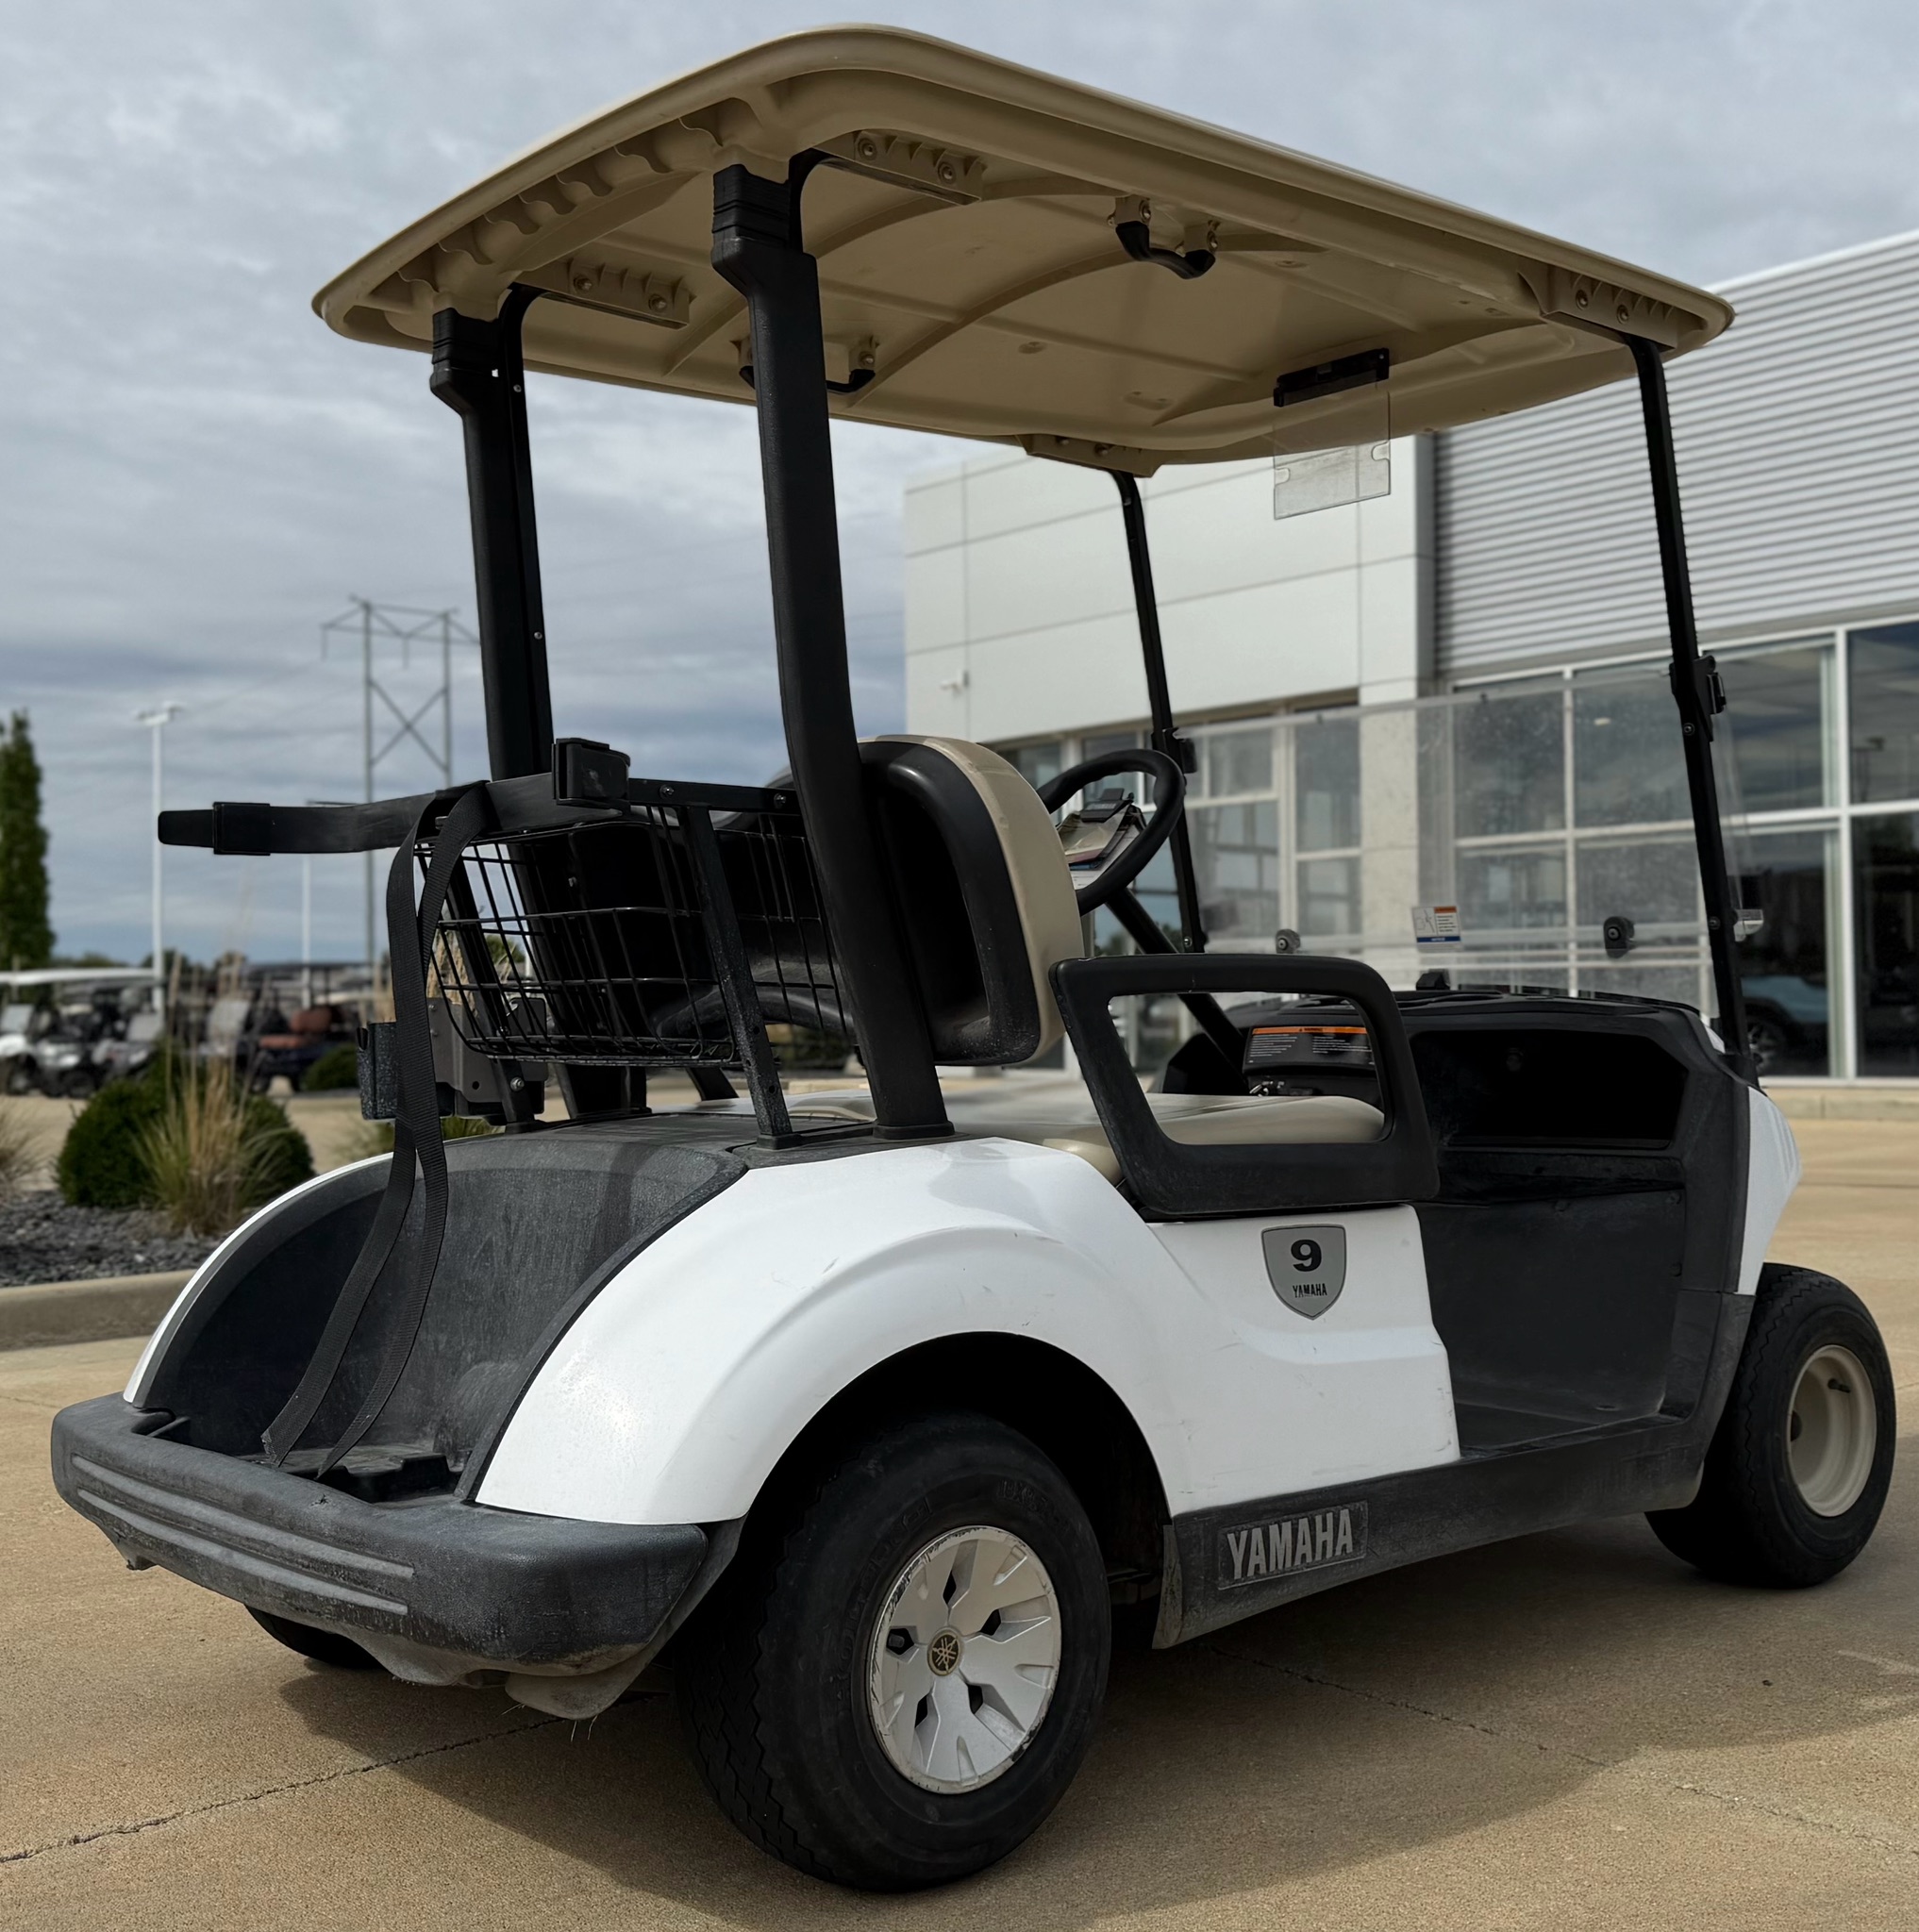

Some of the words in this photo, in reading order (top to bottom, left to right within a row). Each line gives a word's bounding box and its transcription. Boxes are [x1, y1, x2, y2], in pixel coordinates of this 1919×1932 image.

[1291, 1239, 1323, 1273] 9
[1292, 1283, 1327, 1298] YAMAHA
[1226, 1508, 1354, 1580] YAMAHA
